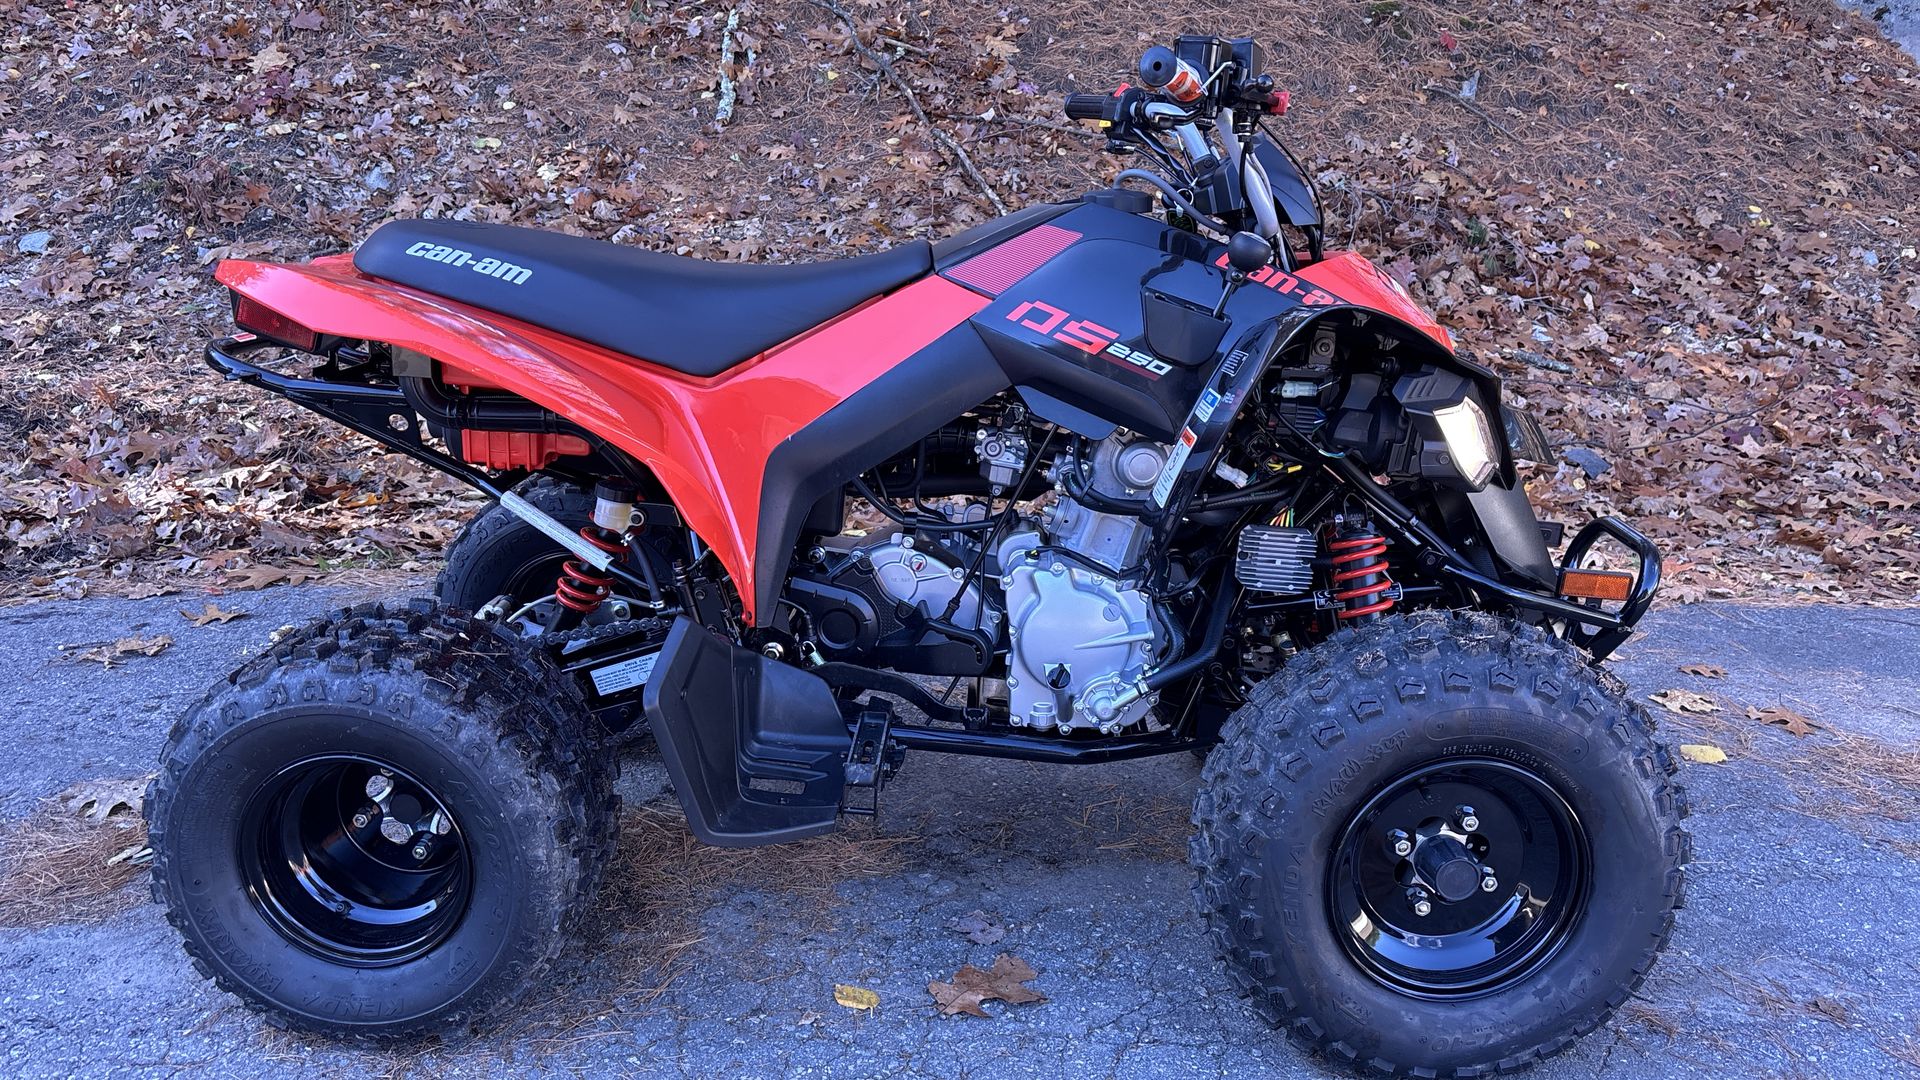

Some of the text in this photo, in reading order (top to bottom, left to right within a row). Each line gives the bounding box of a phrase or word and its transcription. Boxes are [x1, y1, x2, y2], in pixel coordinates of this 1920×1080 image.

[405, 241, 533, 285] can-am
[1214, 252, 1346, 305] an-a
[1005, 300, 1121, 356] DS
[1106, 342, 1173, 376] 250
[301, 993, 406, 1018] KENDA
